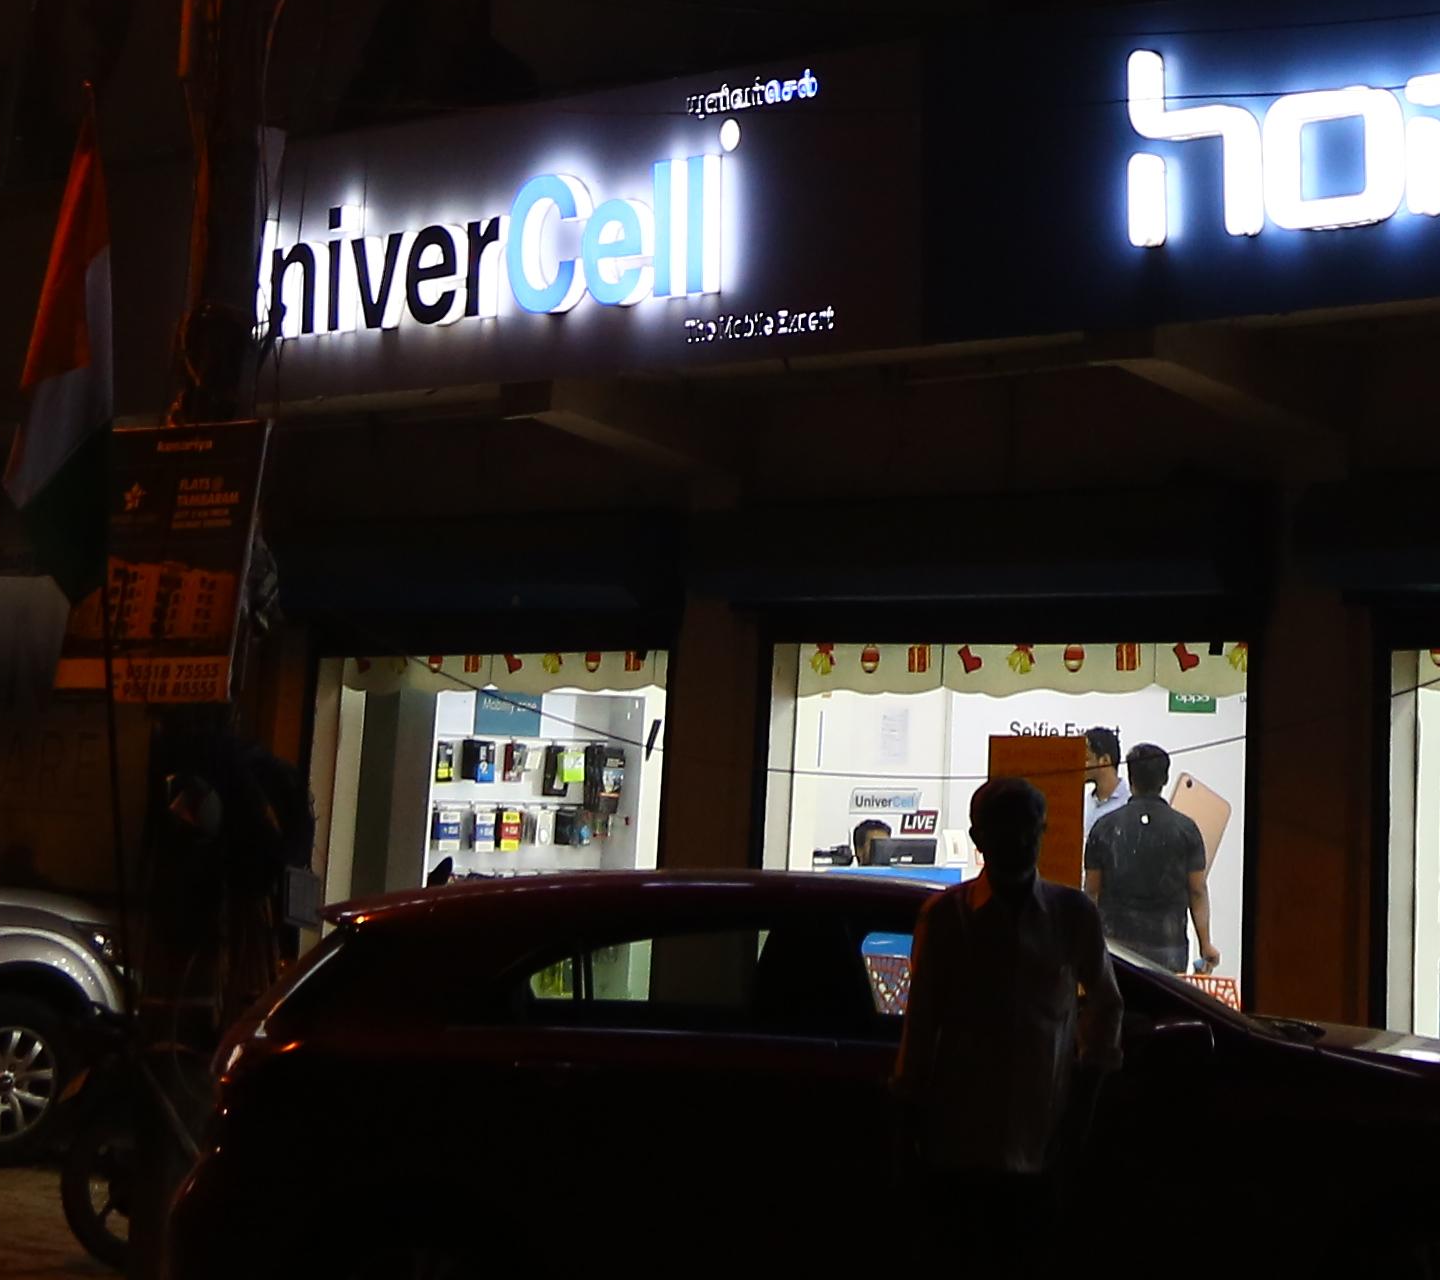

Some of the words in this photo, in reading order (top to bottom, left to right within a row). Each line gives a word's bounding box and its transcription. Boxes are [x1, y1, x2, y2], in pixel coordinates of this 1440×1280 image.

[253, 135, 725, 342] niverCell
[855, 794, 916, 809] UniverCell
[903, 814, 935, 832] LIVE
